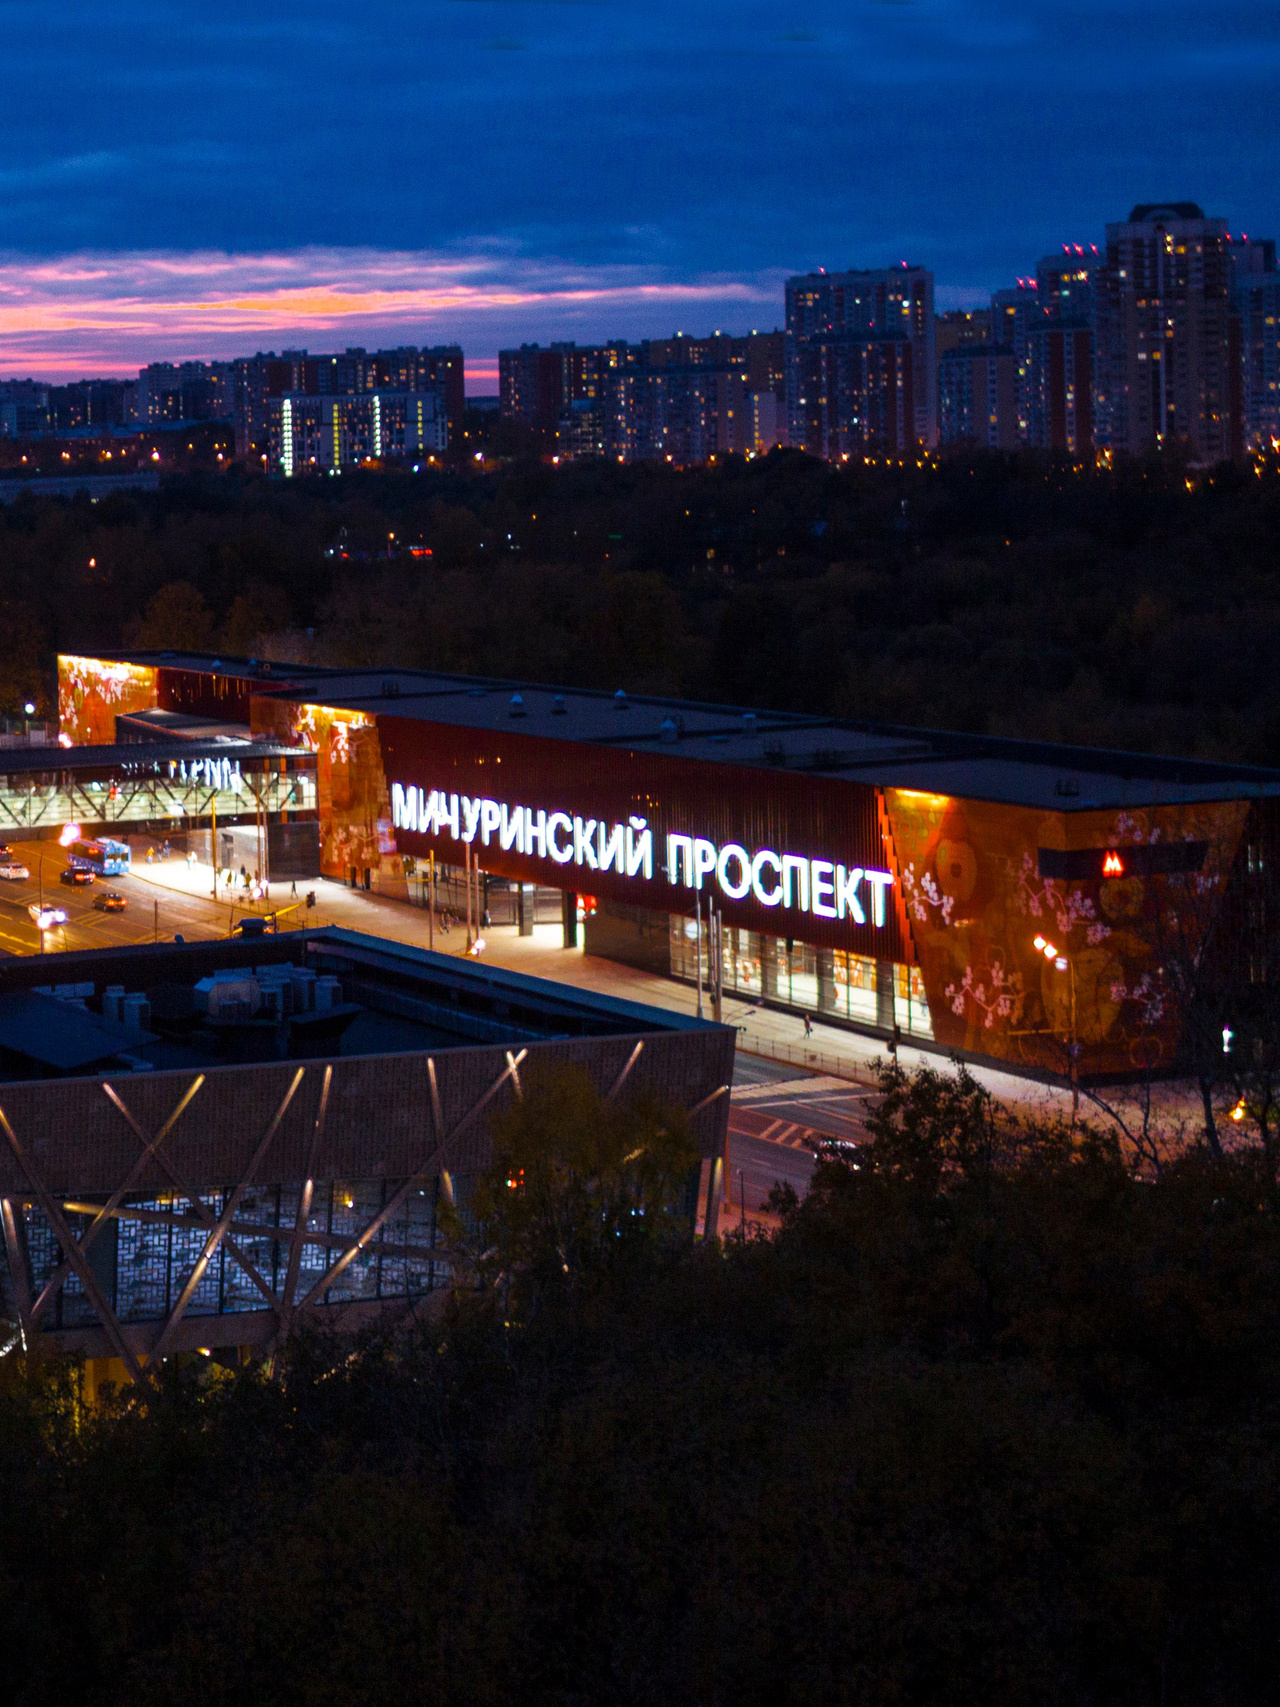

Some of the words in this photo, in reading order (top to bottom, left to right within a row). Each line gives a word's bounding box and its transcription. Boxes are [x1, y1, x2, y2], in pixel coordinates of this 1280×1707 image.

[390, 781, 653, 881] МИЧУРИНСКИЙ
[664, 832, 895, 929] ПРОСПЕКТ
[1102, 850, 1124, 877] М
